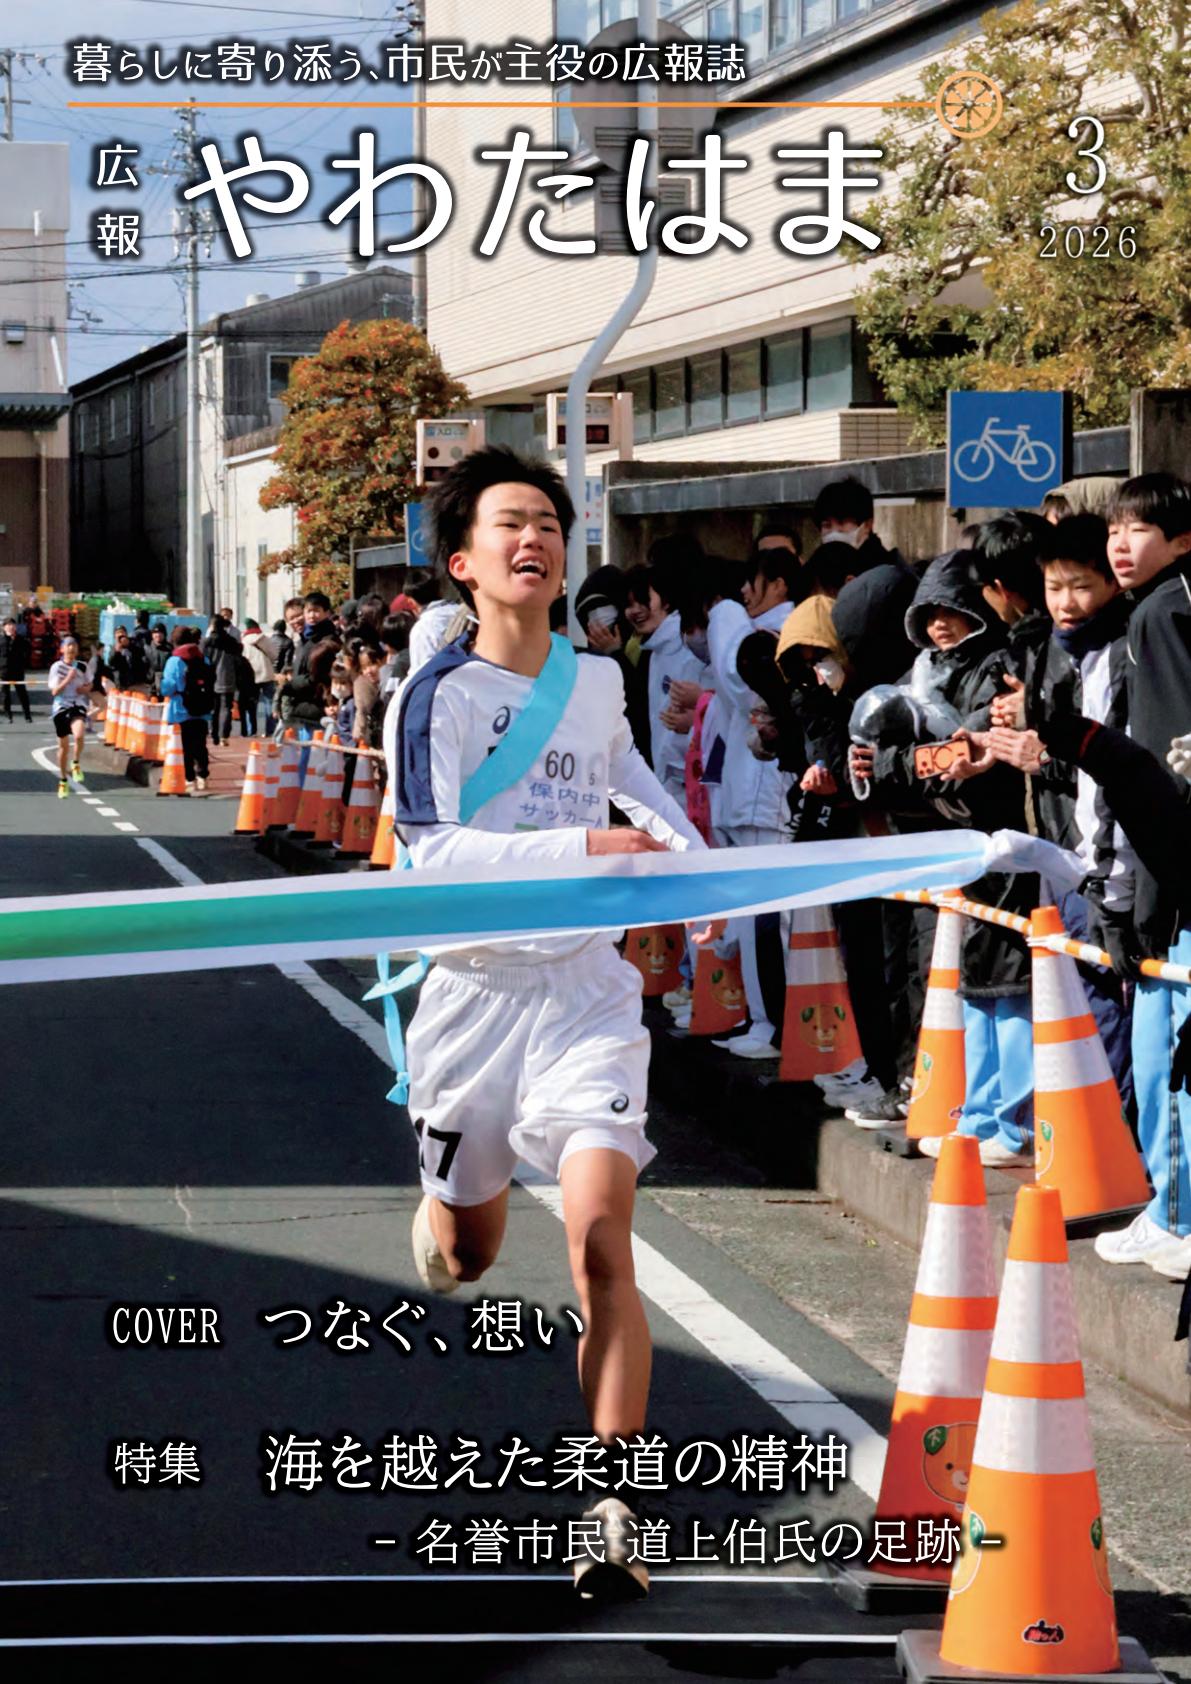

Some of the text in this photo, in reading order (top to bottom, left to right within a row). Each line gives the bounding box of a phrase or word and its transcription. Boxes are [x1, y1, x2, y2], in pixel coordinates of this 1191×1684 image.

[545, 750, 575, 781] 60
[529, 782, 600, 807] 保内中
